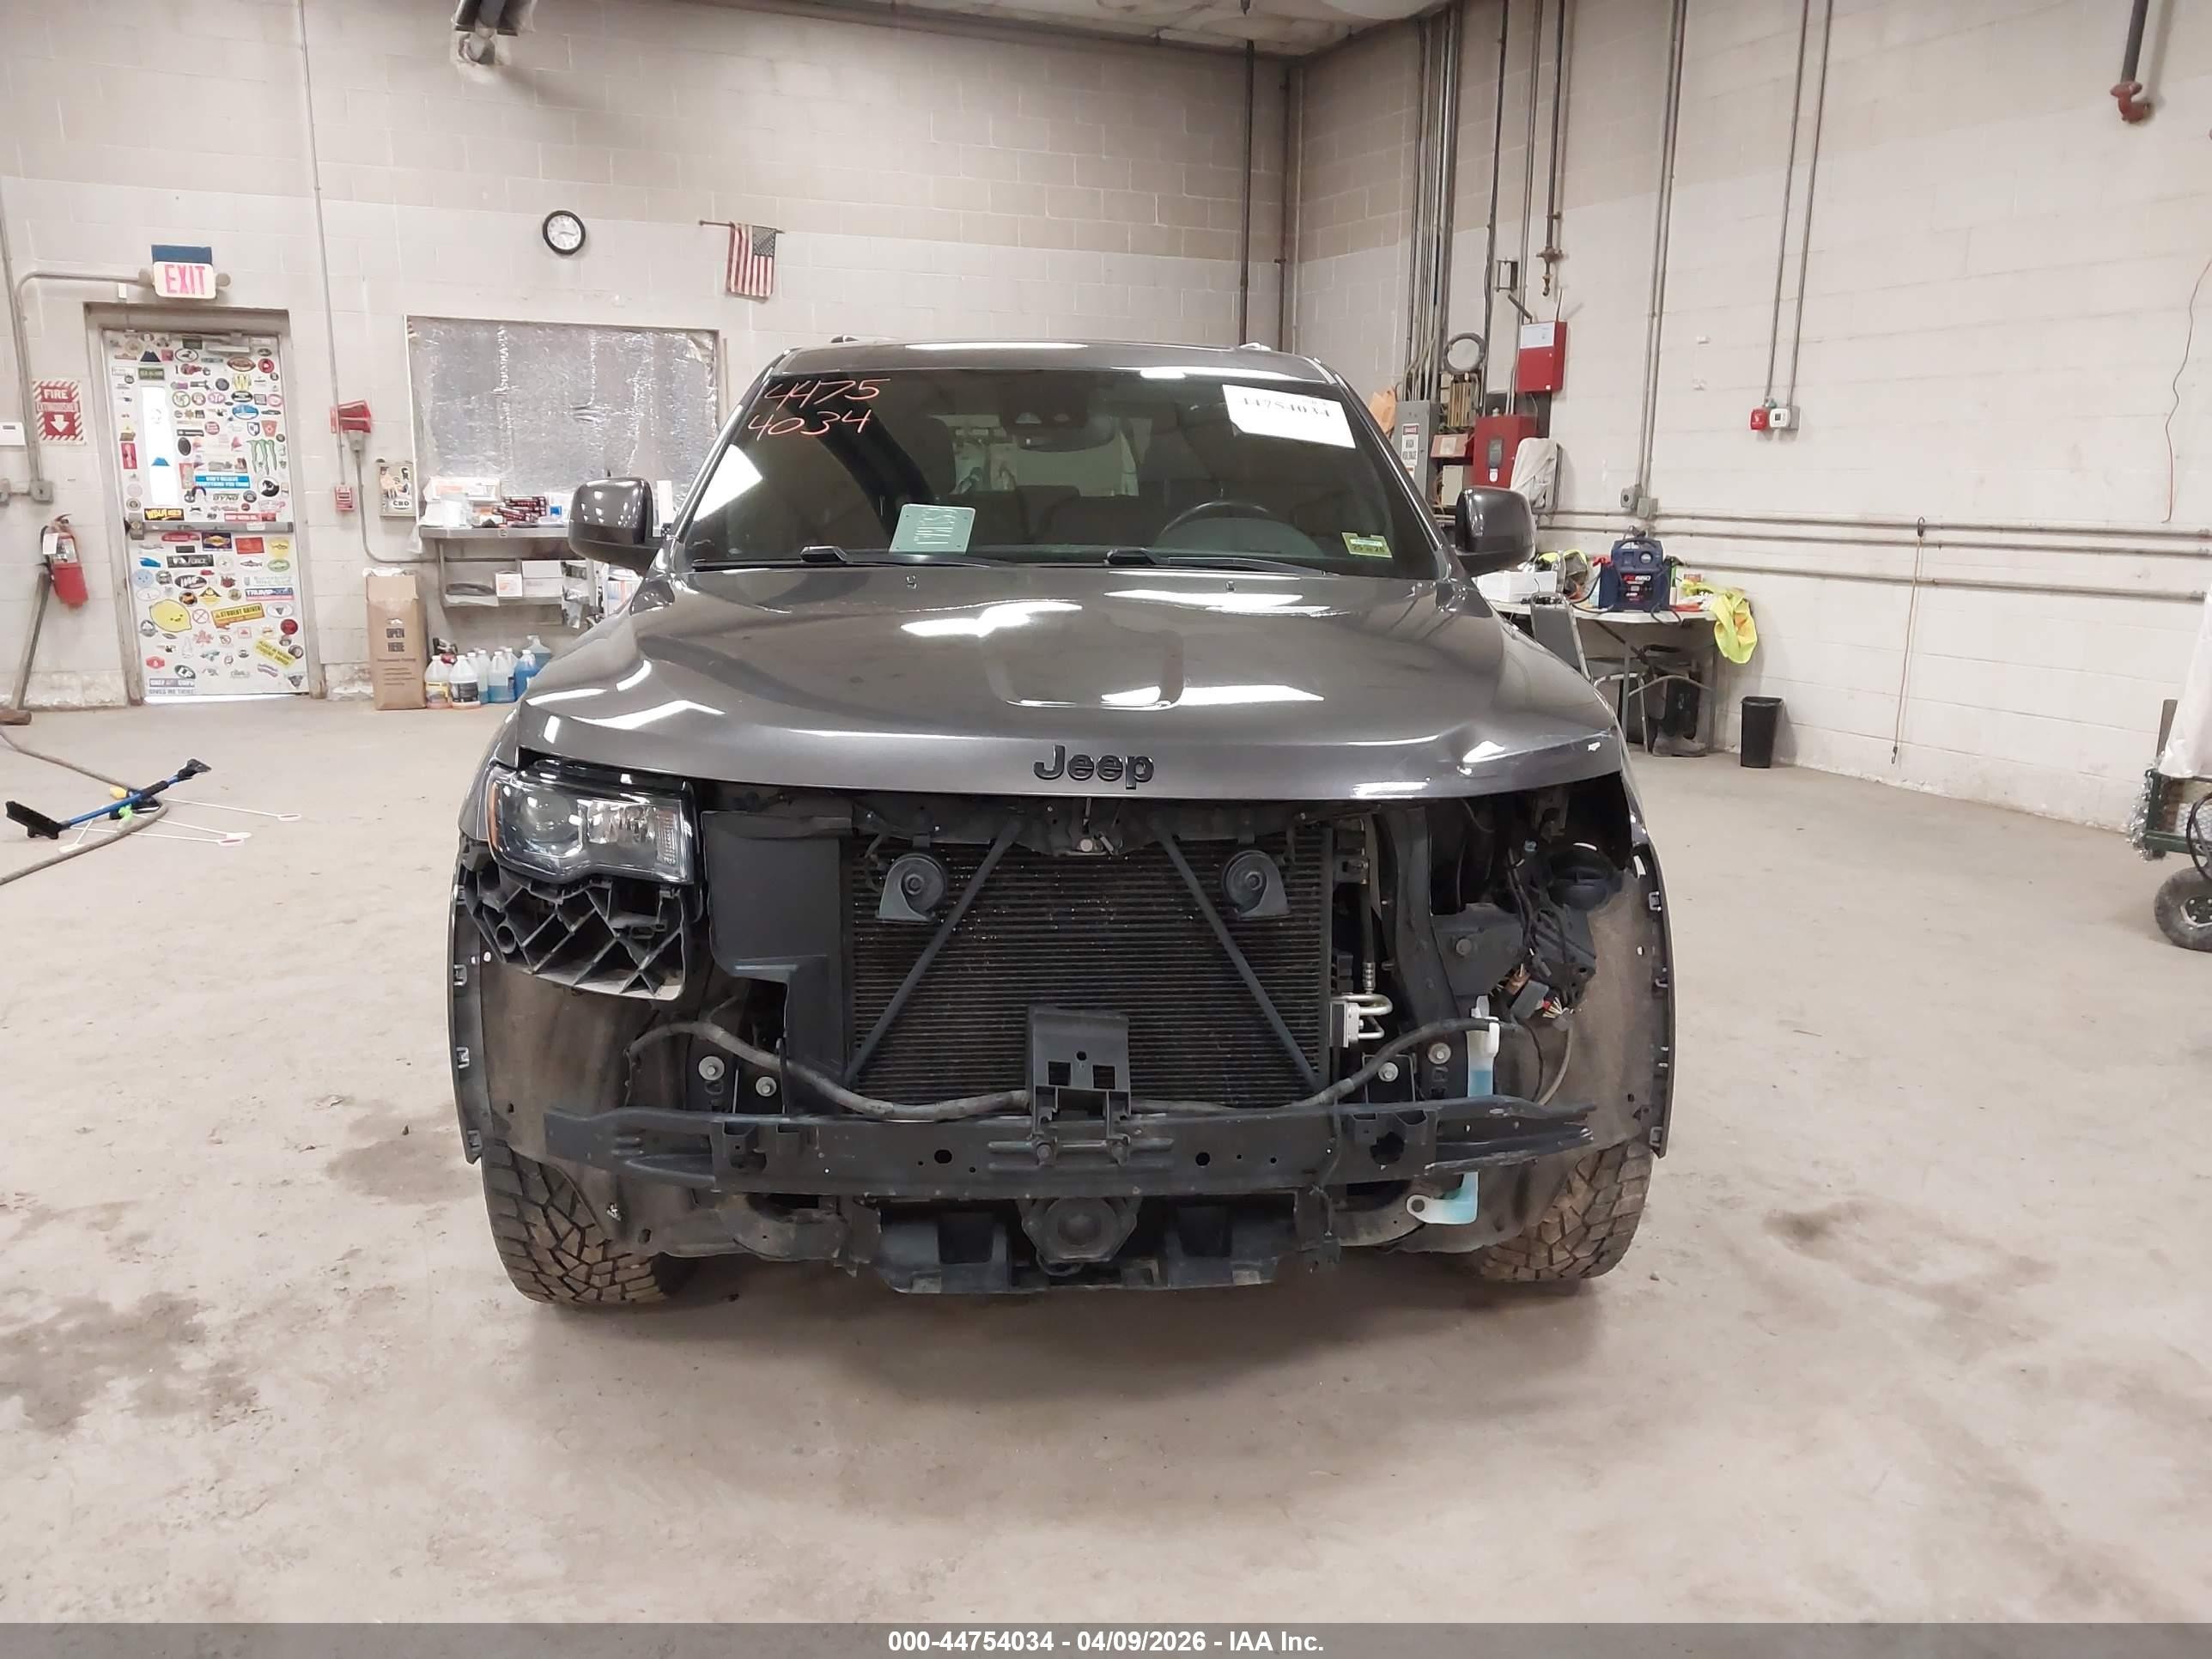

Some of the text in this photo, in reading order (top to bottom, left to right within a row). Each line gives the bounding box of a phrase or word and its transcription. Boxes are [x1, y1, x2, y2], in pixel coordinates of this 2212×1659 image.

[165, 264, 206, 295] EXIT
[44, 389, 69, 399] FIRE
[764, 379, 890, 410] 4475
[748, 410, 872, 441] 4034
[1034, 744, 1154, 790] Jeep
